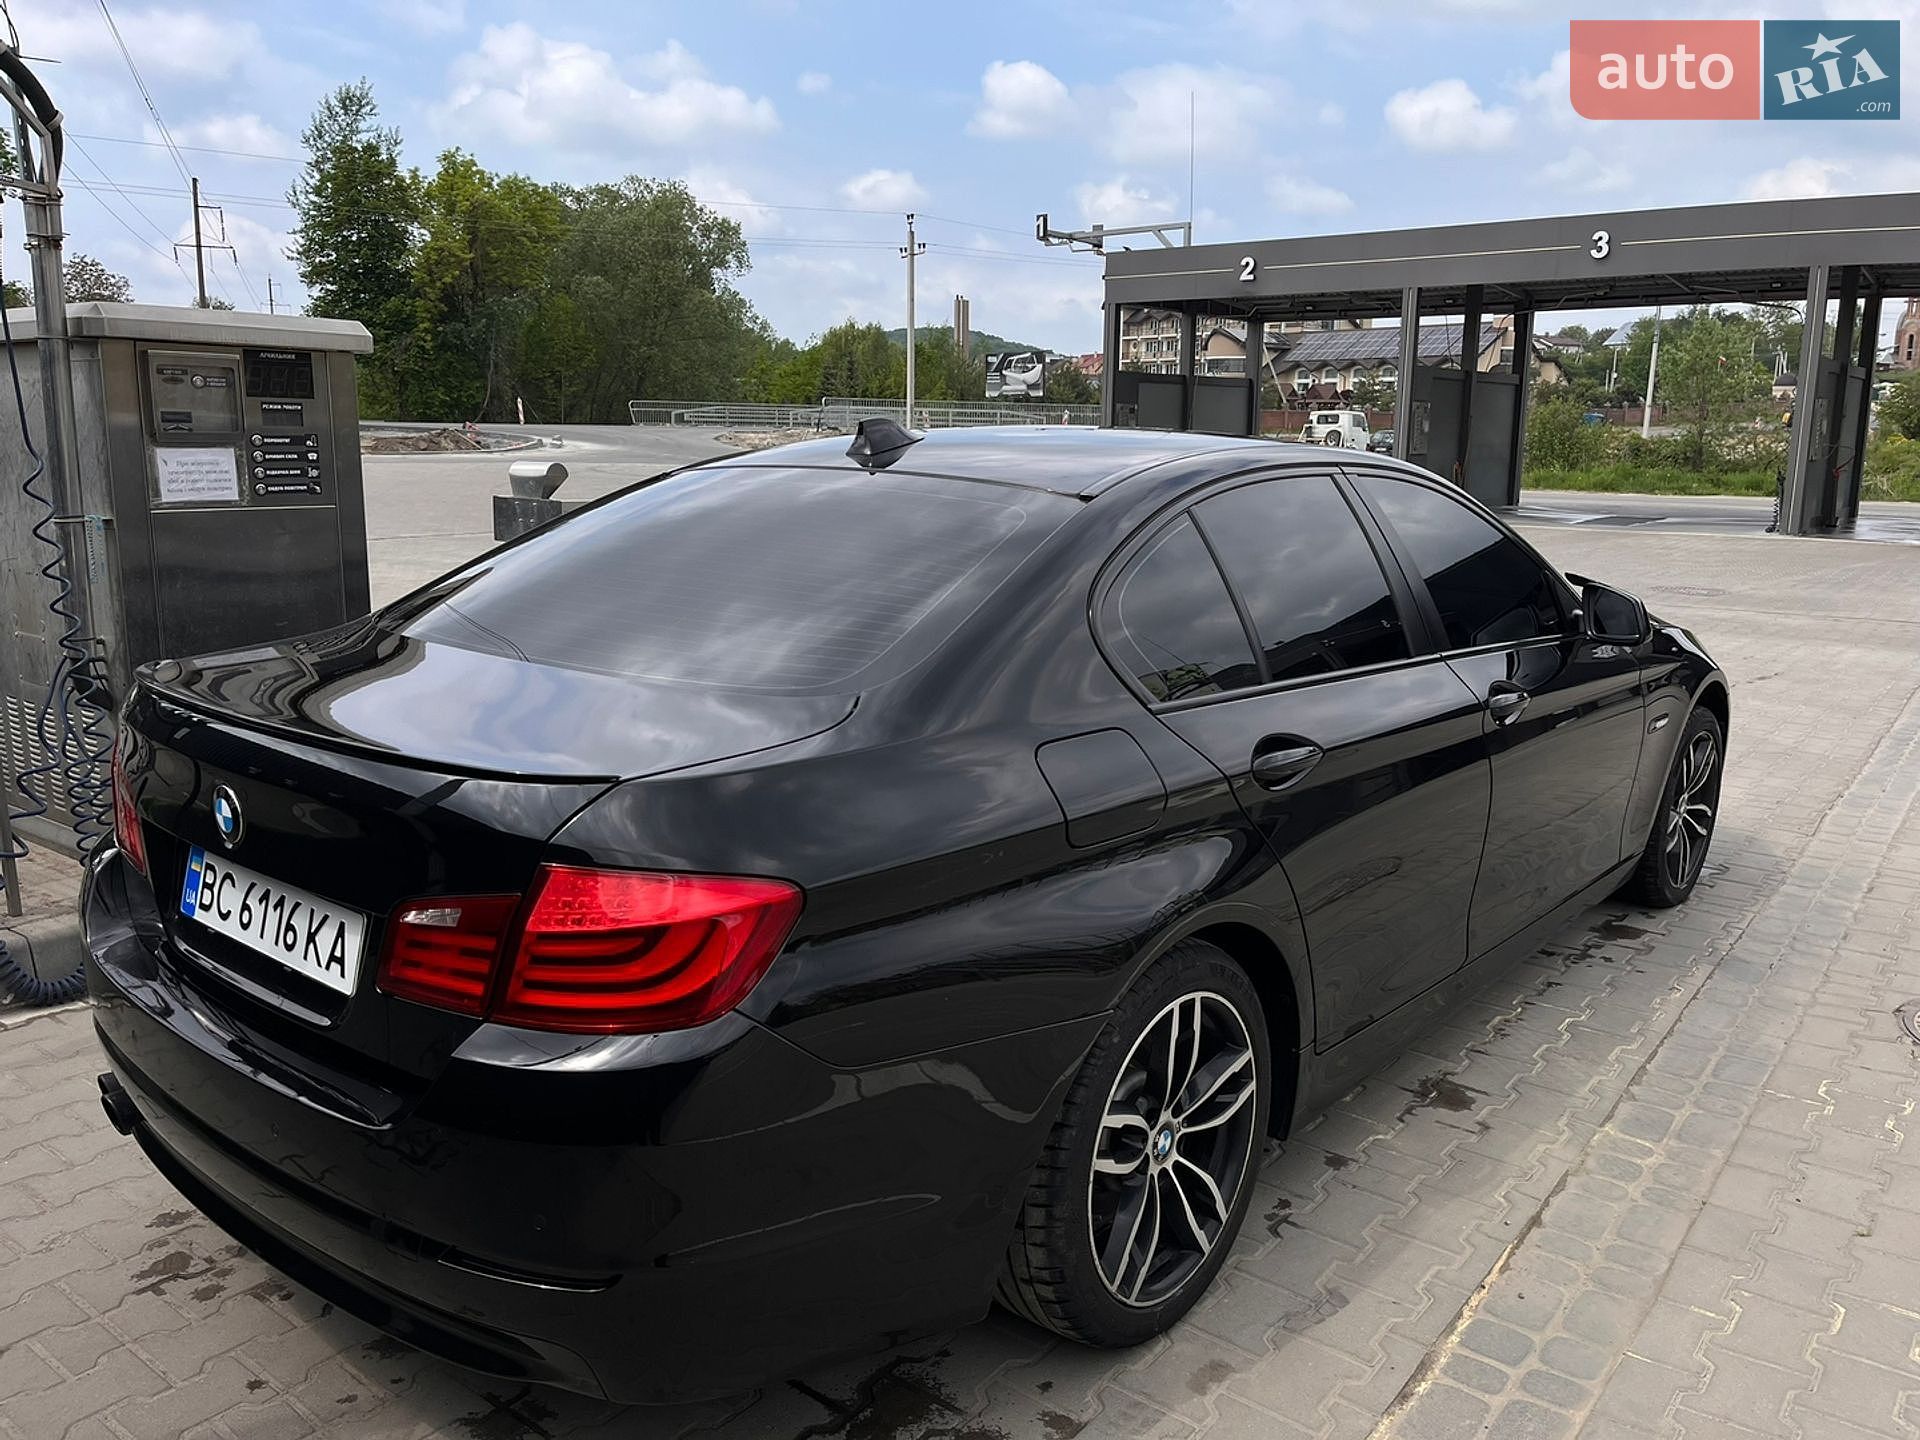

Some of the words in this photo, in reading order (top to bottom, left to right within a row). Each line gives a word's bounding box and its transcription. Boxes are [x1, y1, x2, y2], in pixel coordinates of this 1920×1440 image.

[1590, 230, 1610, 259] 3
[1239, 256, 1256, 281] 2
[185, 887, 197, 906] UA
[198, 861, 237, 922] BC
[238, 881, 303, 953] 6116
[302, 907, 346, 979] KA
